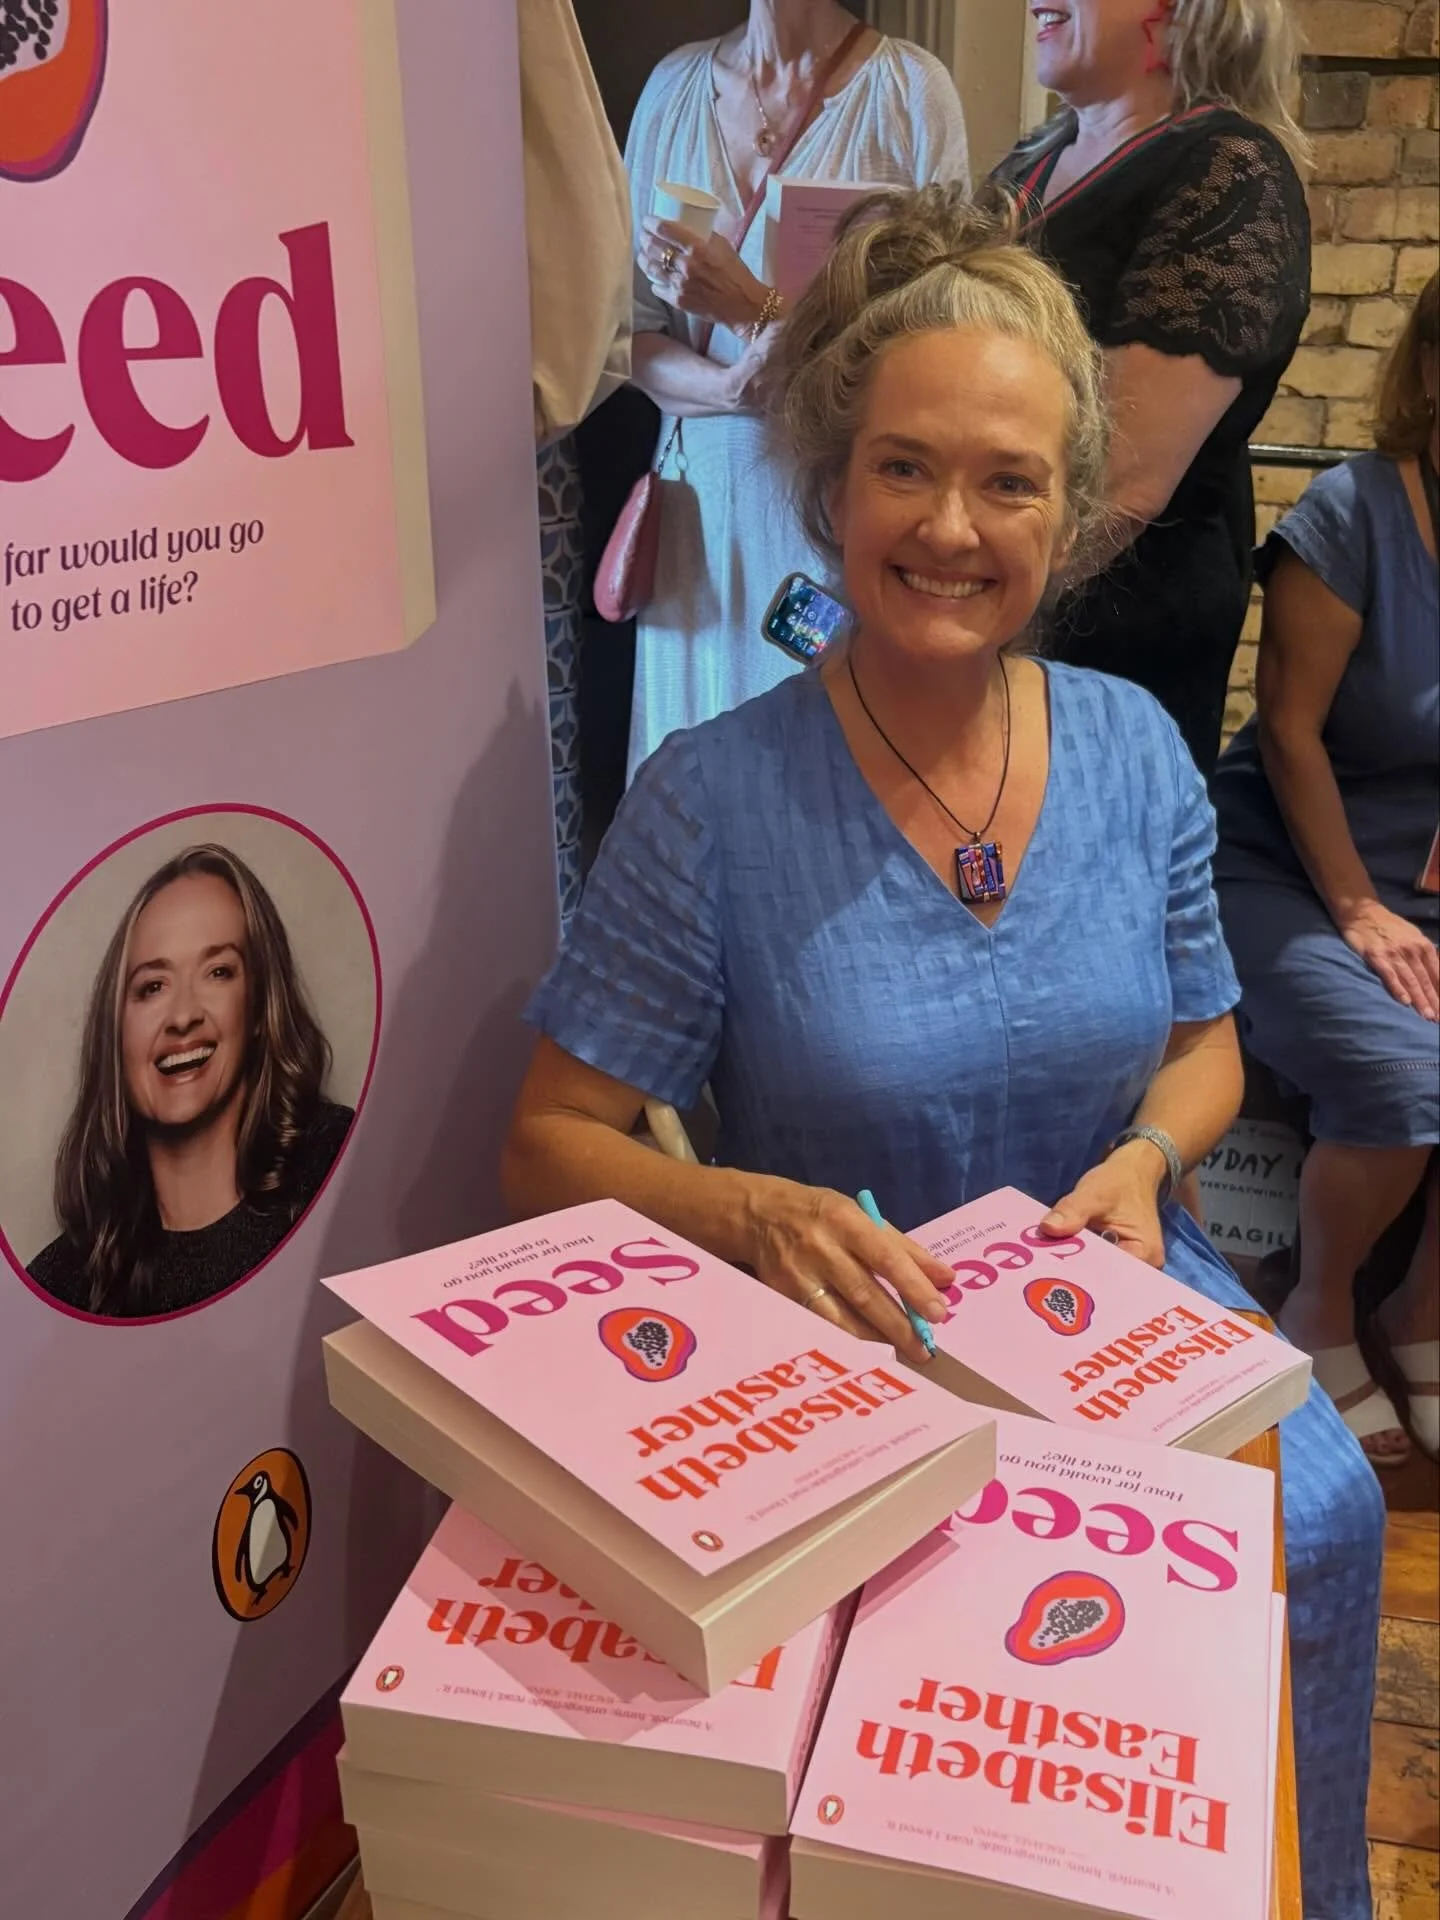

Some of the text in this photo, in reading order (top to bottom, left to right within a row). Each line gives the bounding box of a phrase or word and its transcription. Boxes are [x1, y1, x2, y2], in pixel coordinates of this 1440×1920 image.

[5, 519, 264, 587] far would you go
[11, 570, 199, 632] to get a life?
[1201, 1147, 1284, 1180] YDAY
[493, 1253, 539, 1273] would
[497, 1251, 509, 1260] a
[535, 1238, 551, 1247] to
[1207, 1221, 1292, 1248] RAGIL
[411, 1237, 701, 1358] Seed
[464, 1269, 493, 1283] you
[1060, 1305, 1208, 1393] Easther
[1073, 1319, 1255, 1423] Elisabeth
[627, 1349, 852, 1458] Easther
[636, 1367, 918, 1502] Elisabeth
[999, 1454, 1184, 1503] How far would you go
[1041, 1451, 1143, 1480] to get a life?
[428, 1599, 784, 1691] Eabeth
[899, 1678, 1200, 1786] Easther
[856, 1719, 1230, 1854] Elisabeth
